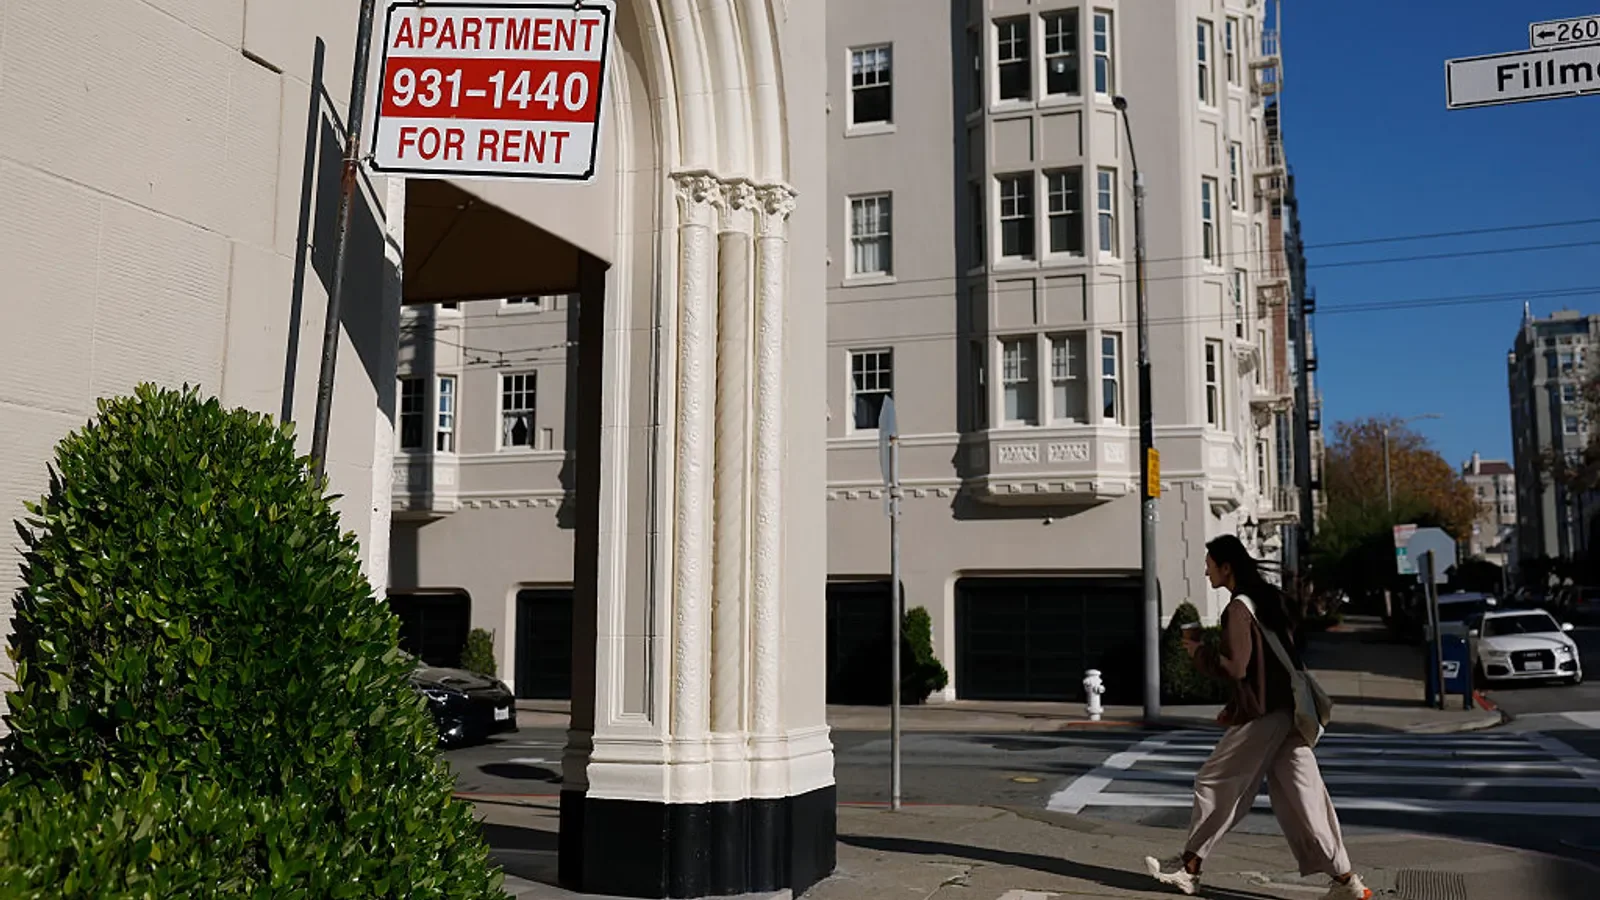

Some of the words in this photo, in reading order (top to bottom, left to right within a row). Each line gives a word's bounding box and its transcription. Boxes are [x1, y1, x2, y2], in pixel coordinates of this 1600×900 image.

[394, 17, 599, 51] APARTMENT
[392, 68, 589, 111] 931-1440
[1497, 59, 1600, 92] Fillm
[397, 127, 465, 161] FOR
[477, 129, 570, 163] RENT
